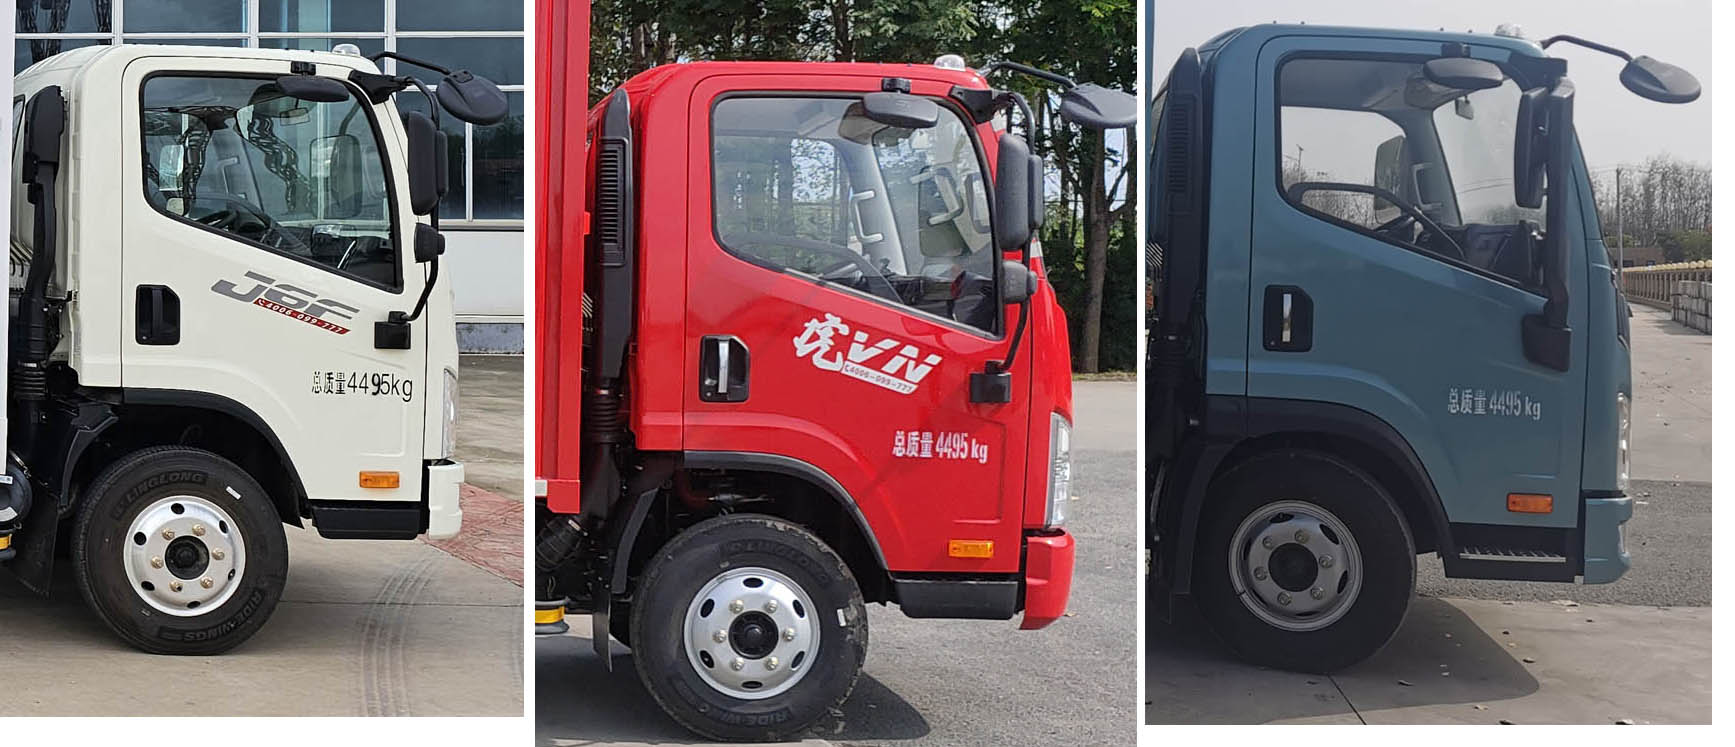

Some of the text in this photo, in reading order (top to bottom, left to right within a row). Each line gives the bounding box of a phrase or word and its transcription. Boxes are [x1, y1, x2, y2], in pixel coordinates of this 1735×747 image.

[266, 302, 344, 333] 4006-099-777
[1447, 387, 1541, 421] 总质量 4495 kg
[892, 430, 989, 464] 总质量 4495 kg
[126, 472, 204, 503] LINGLONG
